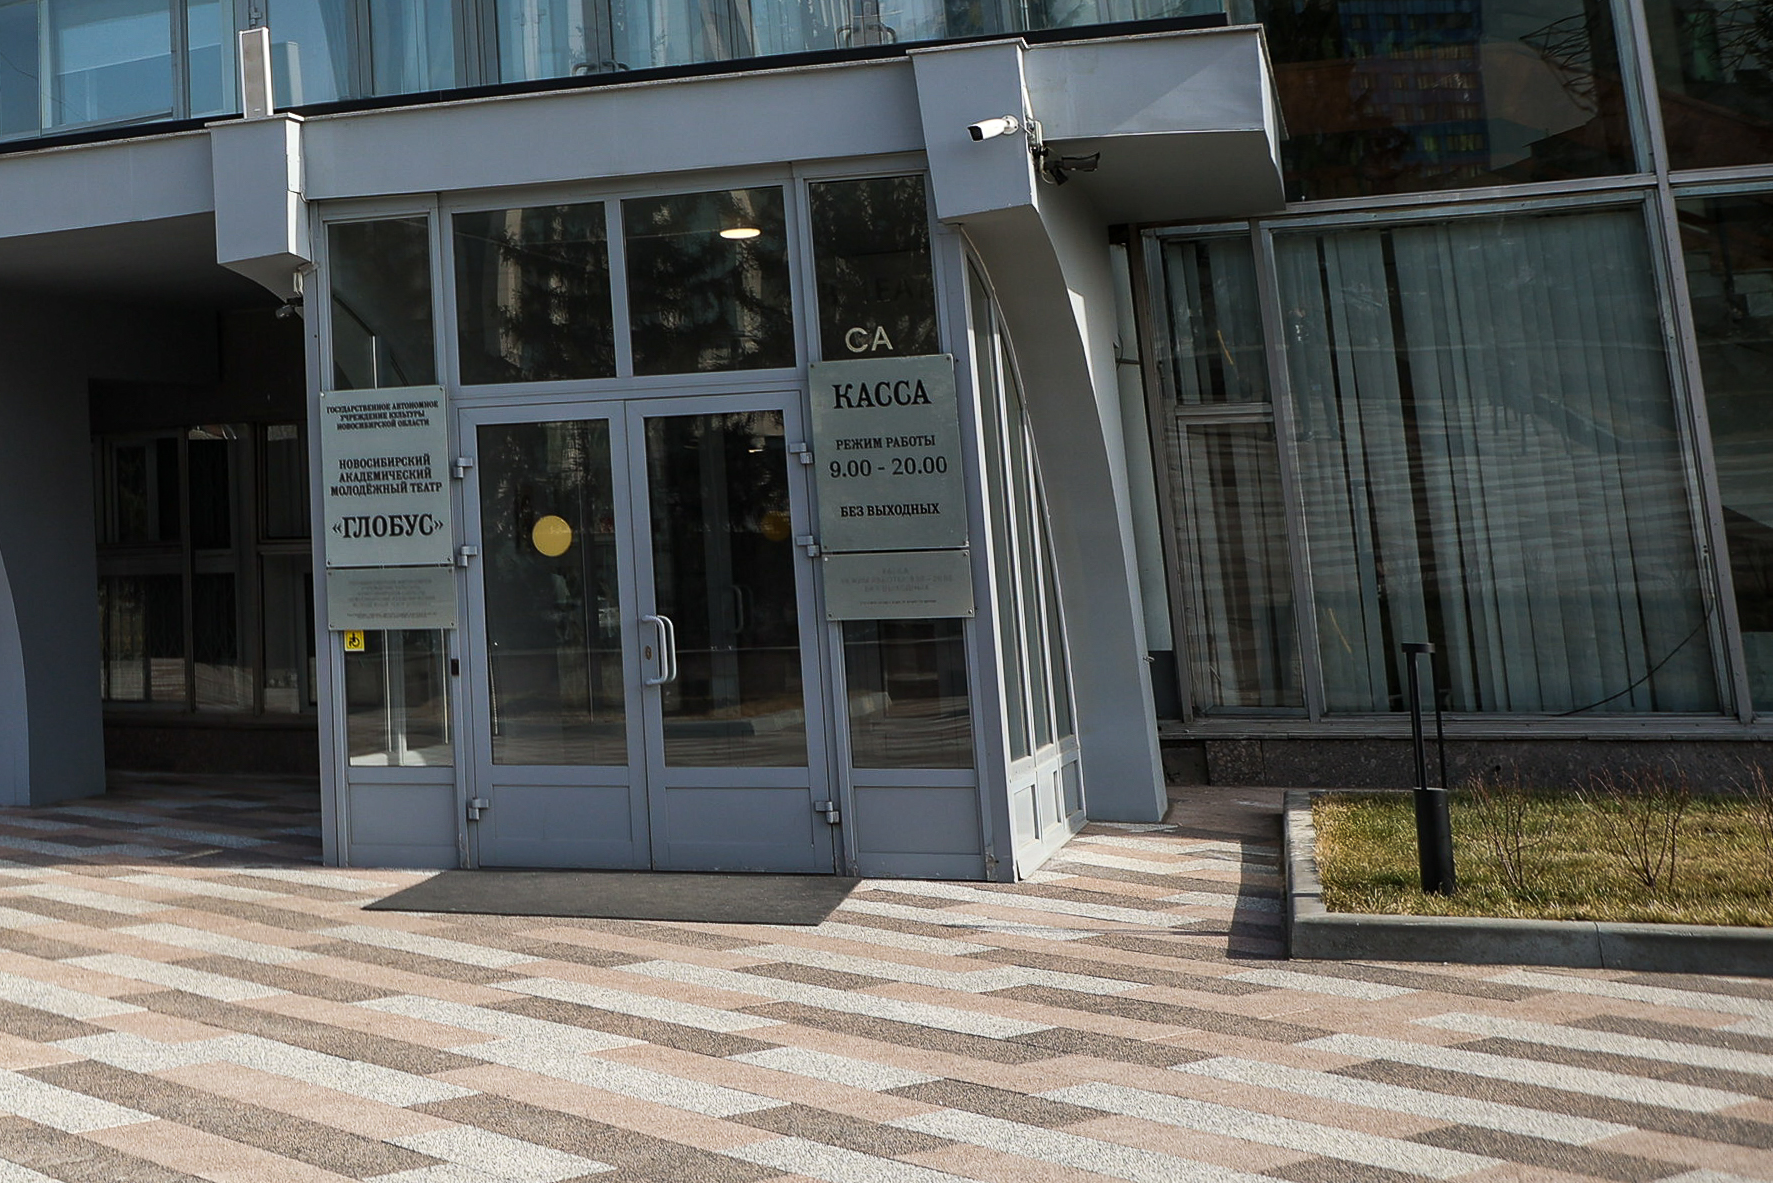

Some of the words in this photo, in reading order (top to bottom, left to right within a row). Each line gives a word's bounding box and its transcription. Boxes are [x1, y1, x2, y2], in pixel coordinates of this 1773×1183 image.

[831, 379, 933, 409] КАССА
[326, 402, 391, 414] ГОСУДАРСТВЕННОЕ
[392, 400, 439, 410] АВТОНОМНОЕ
[336, 419, 397, 430] НОВОСИБИРСКОЙ
[397, 418, 430, 427] ОБЛАСТИ
[340, 412, 388, 422] УЧРЕЖДЕНИЕ
[388, 410, 425, 419] КУЛЬТУРЫ
[836, 438, 882, 450] РЕЖИМ
[885, 435, 935, 448] РАБОТЫ
[339, 453, 431, 469] НОВОСИБИРСКИЙ
[829, 459, 872, 478] 9.00
[891, 456, 947, 475] 20.00
[339, 466, 432, 483] АКАДЕМИЧЕСКИЙ
[330, 481, 408, 497] МОЛОДЁЖНЫЙ
[409, 482, 442, 493] ТЕАТР
[840, 505, 864, 517] БЕЗ
[867, 503, 940, 517] ВЫХОДНЫХ
[332, 513, 444, 538] «ГЛОБУС»
